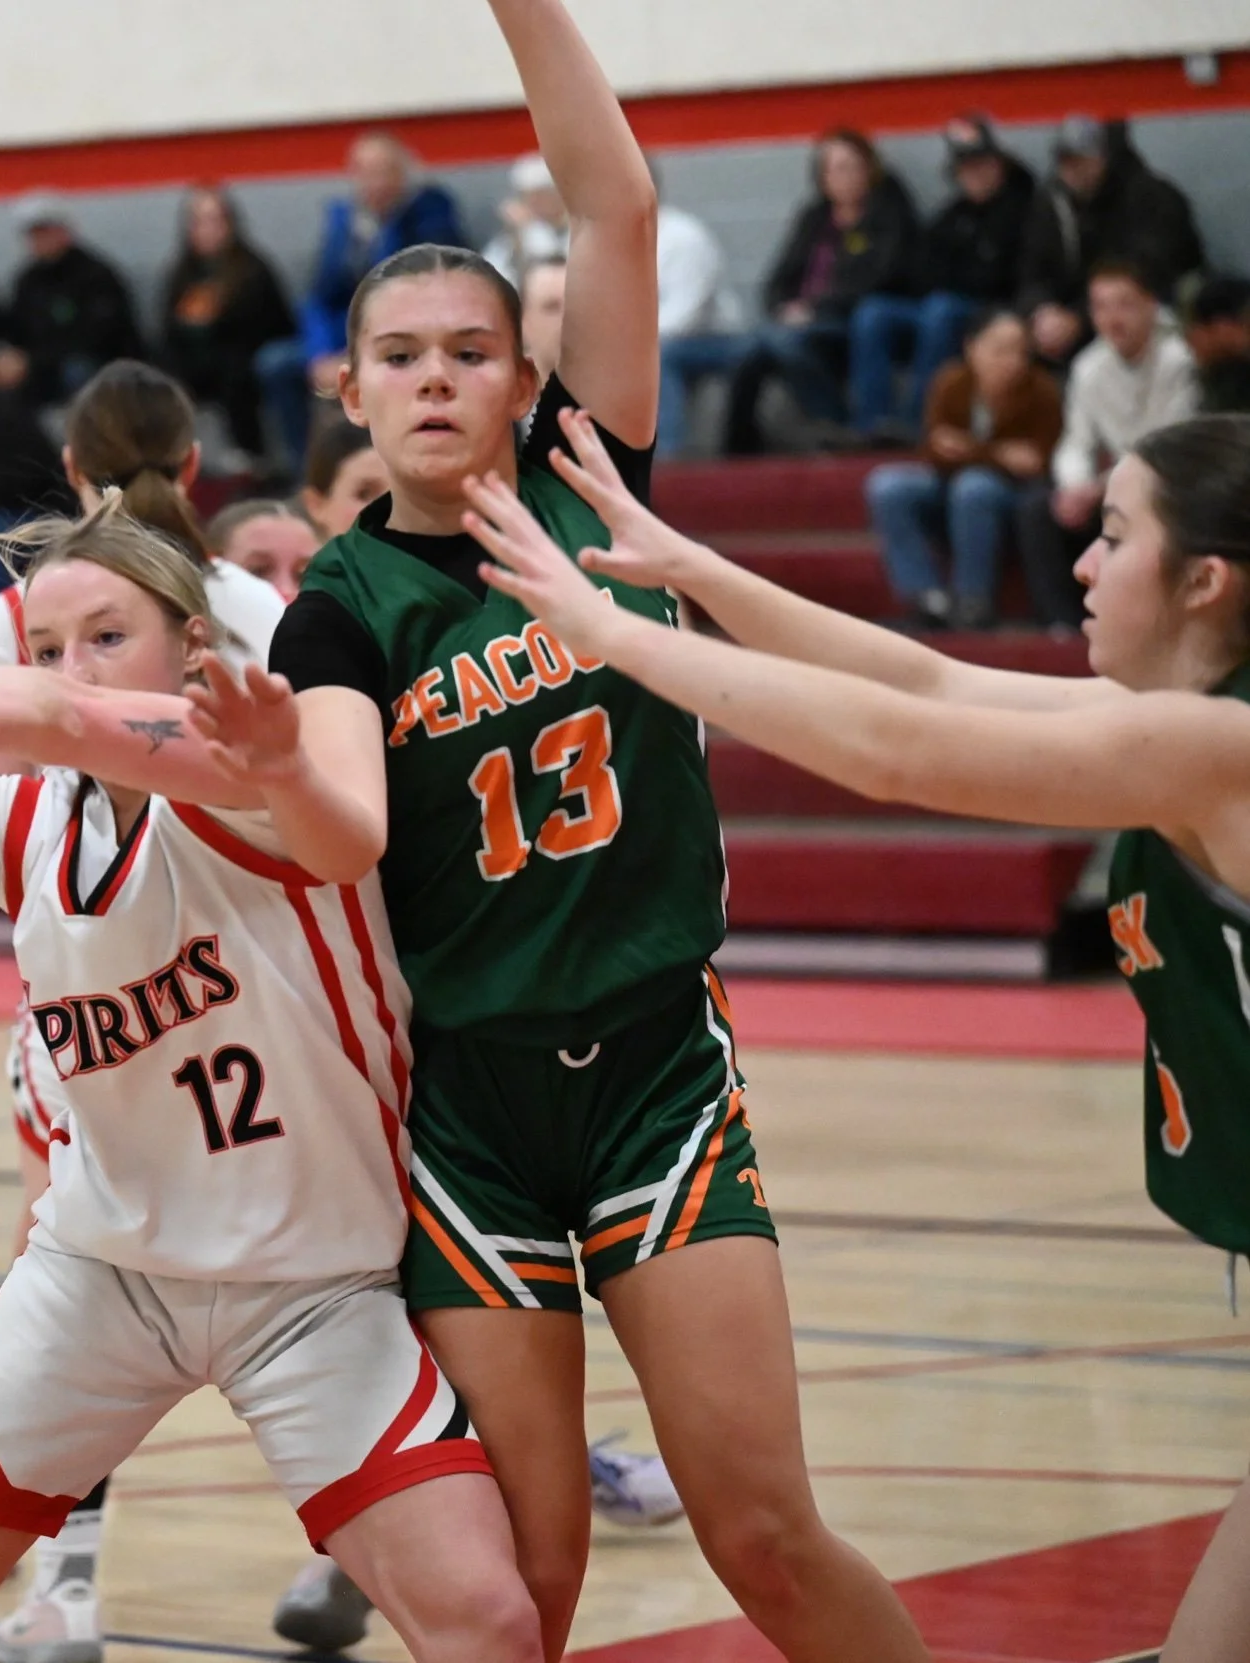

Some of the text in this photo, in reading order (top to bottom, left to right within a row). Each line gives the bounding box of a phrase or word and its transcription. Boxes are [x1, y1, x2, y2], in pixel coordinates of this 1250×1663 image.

[387, 585, 615, 747] PEACO
[468, 704, 623, 882] 13
[22, 934, 240, 1082] PIRITS
[171, 1043, 286, 1155] 12
